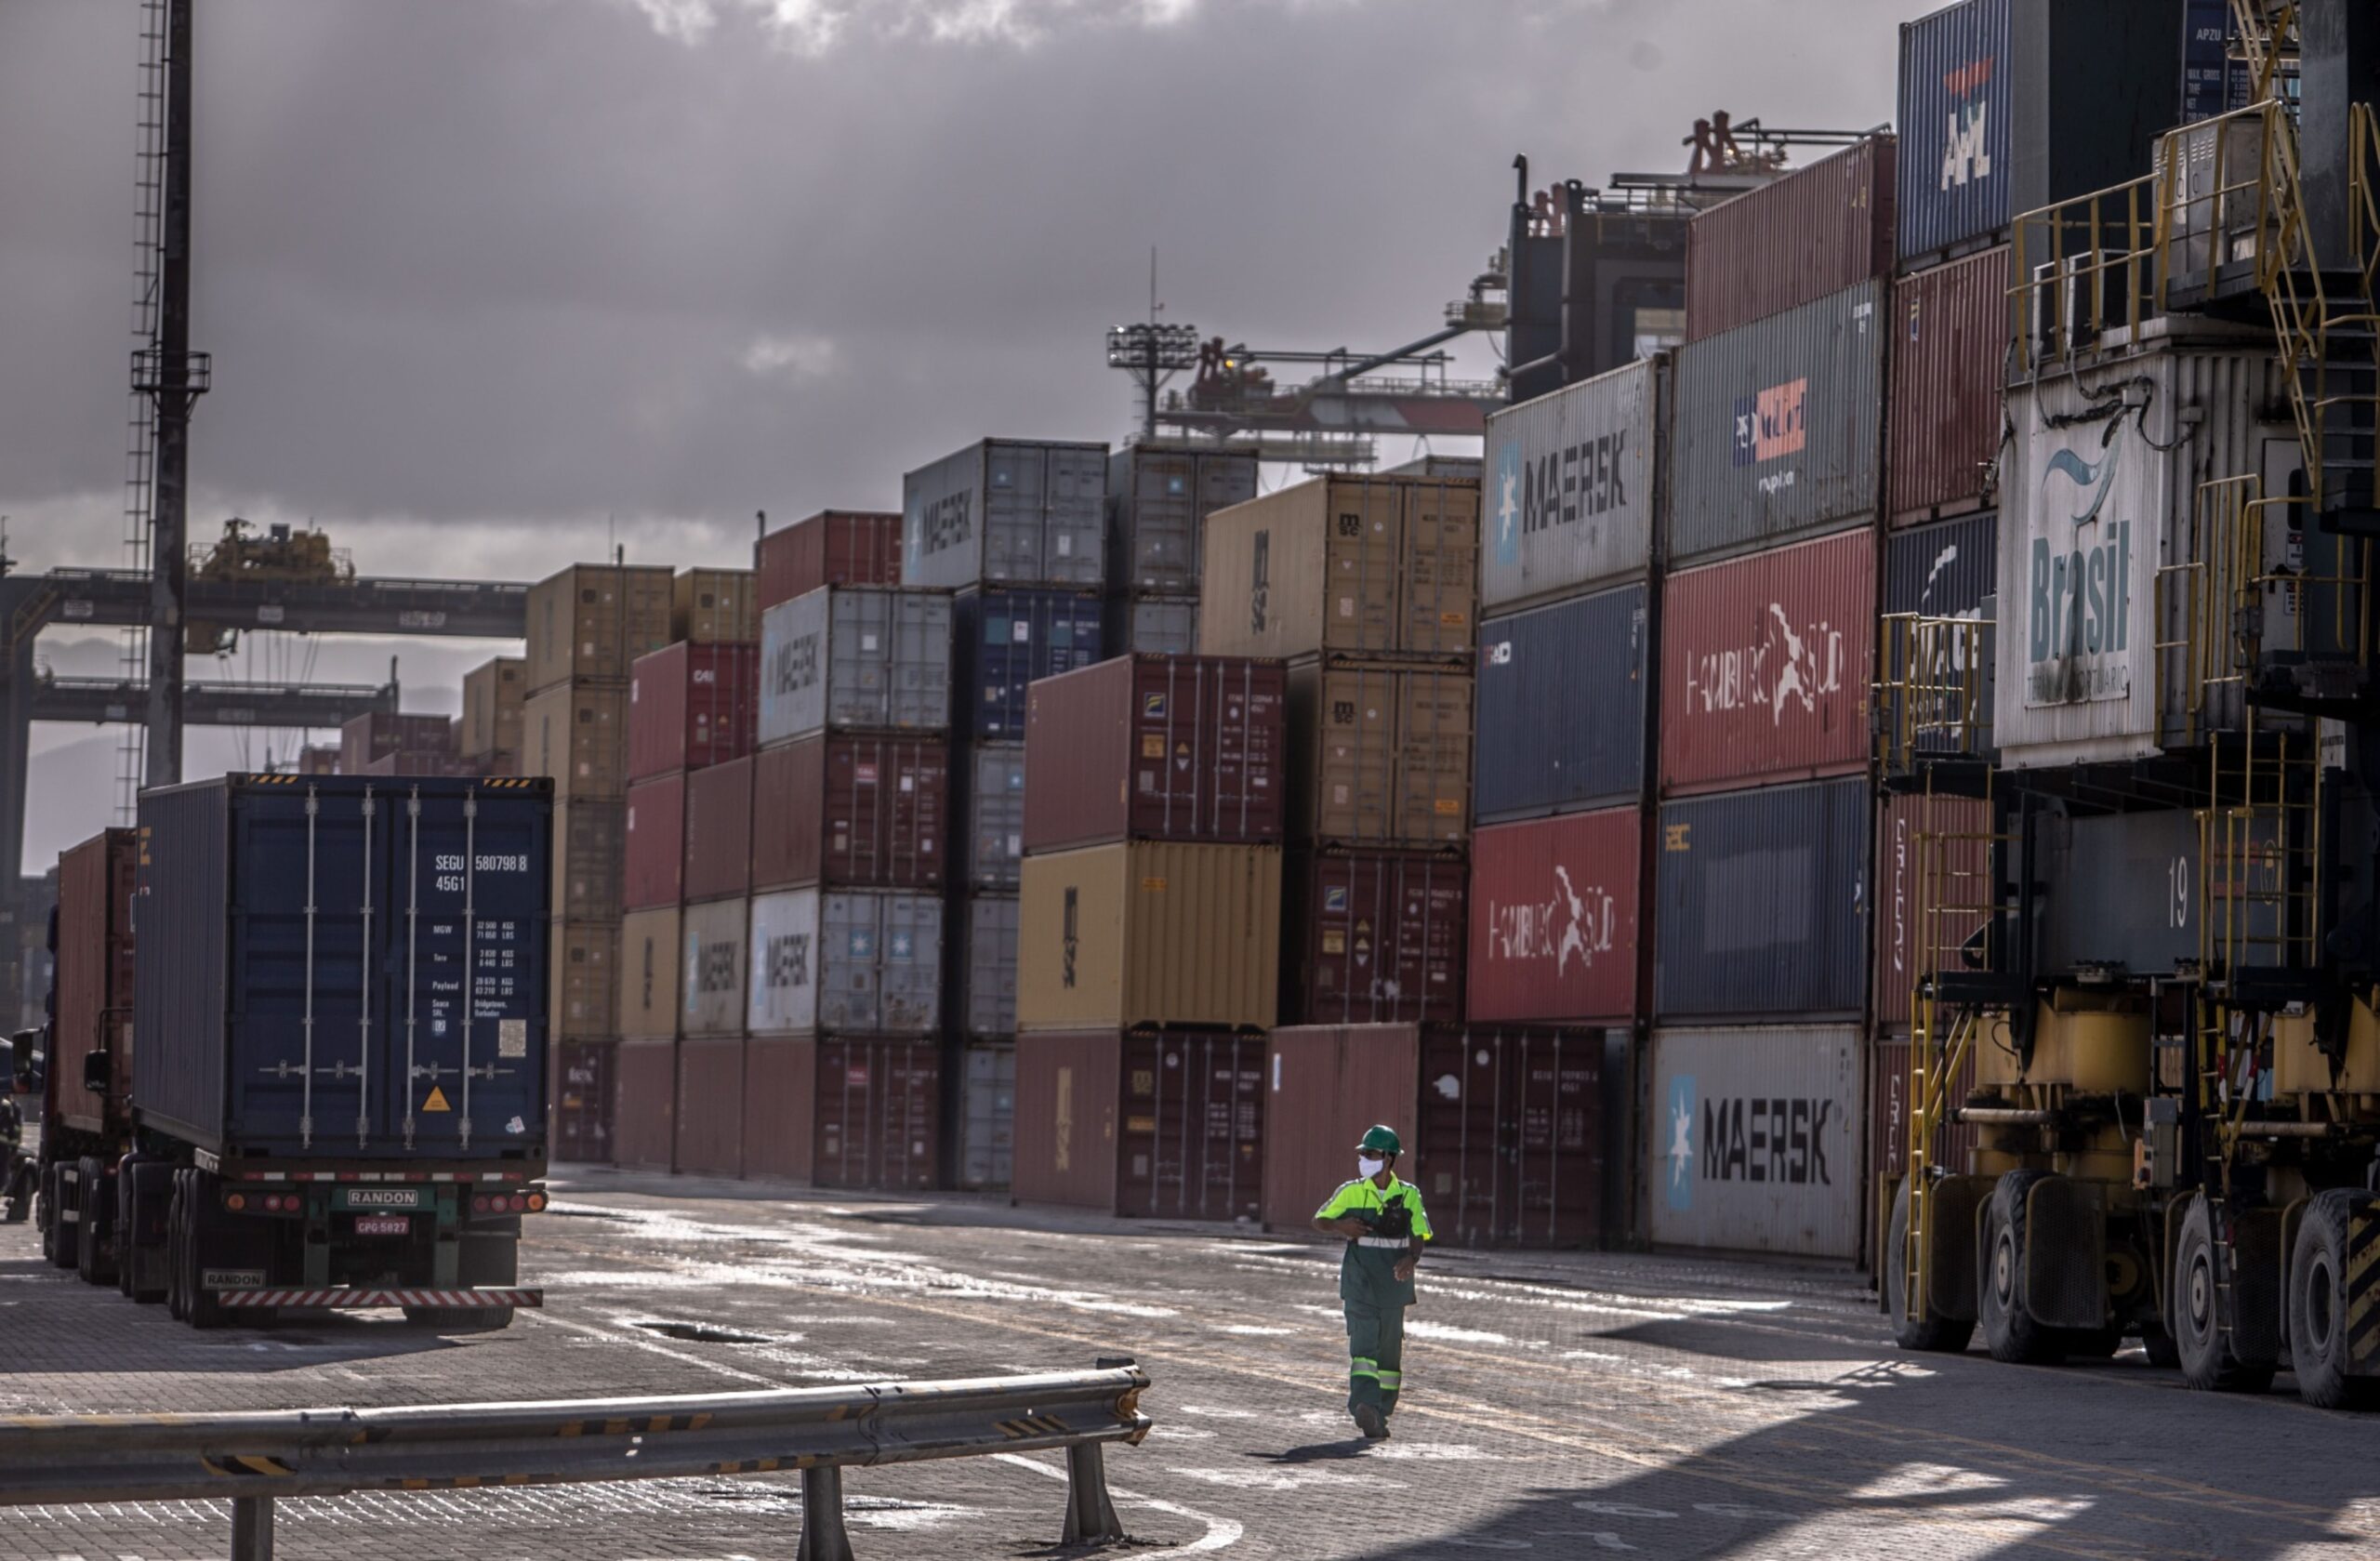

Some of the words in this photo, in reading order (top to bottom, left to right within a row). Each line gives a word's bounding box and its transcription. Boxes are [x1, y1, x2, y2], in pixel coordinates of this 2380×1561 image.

[2196, 27, 2222, 41] APZU
[1523, 428, 1627, 536] MAERSK
[2030, 519, 2131, 664] Brasil
[435, 854, 465, 871] SEGU
[475, 854, 517, 872] 580798
[518, 854, 528, 871] 8
[435, 876, 466, 892] 45G1
[2168, 854, 2188, 929] 19
[432, 925, 453, 934] MGW
[502, 931, 514, 939] LBS
[432, 981, 459, 991] Payload
[1703, 1097, 1833, 1185] MAERSK
[350, 1191, 416, 1205] RANDON
[207, 1274, 261, 1286] RANDON
